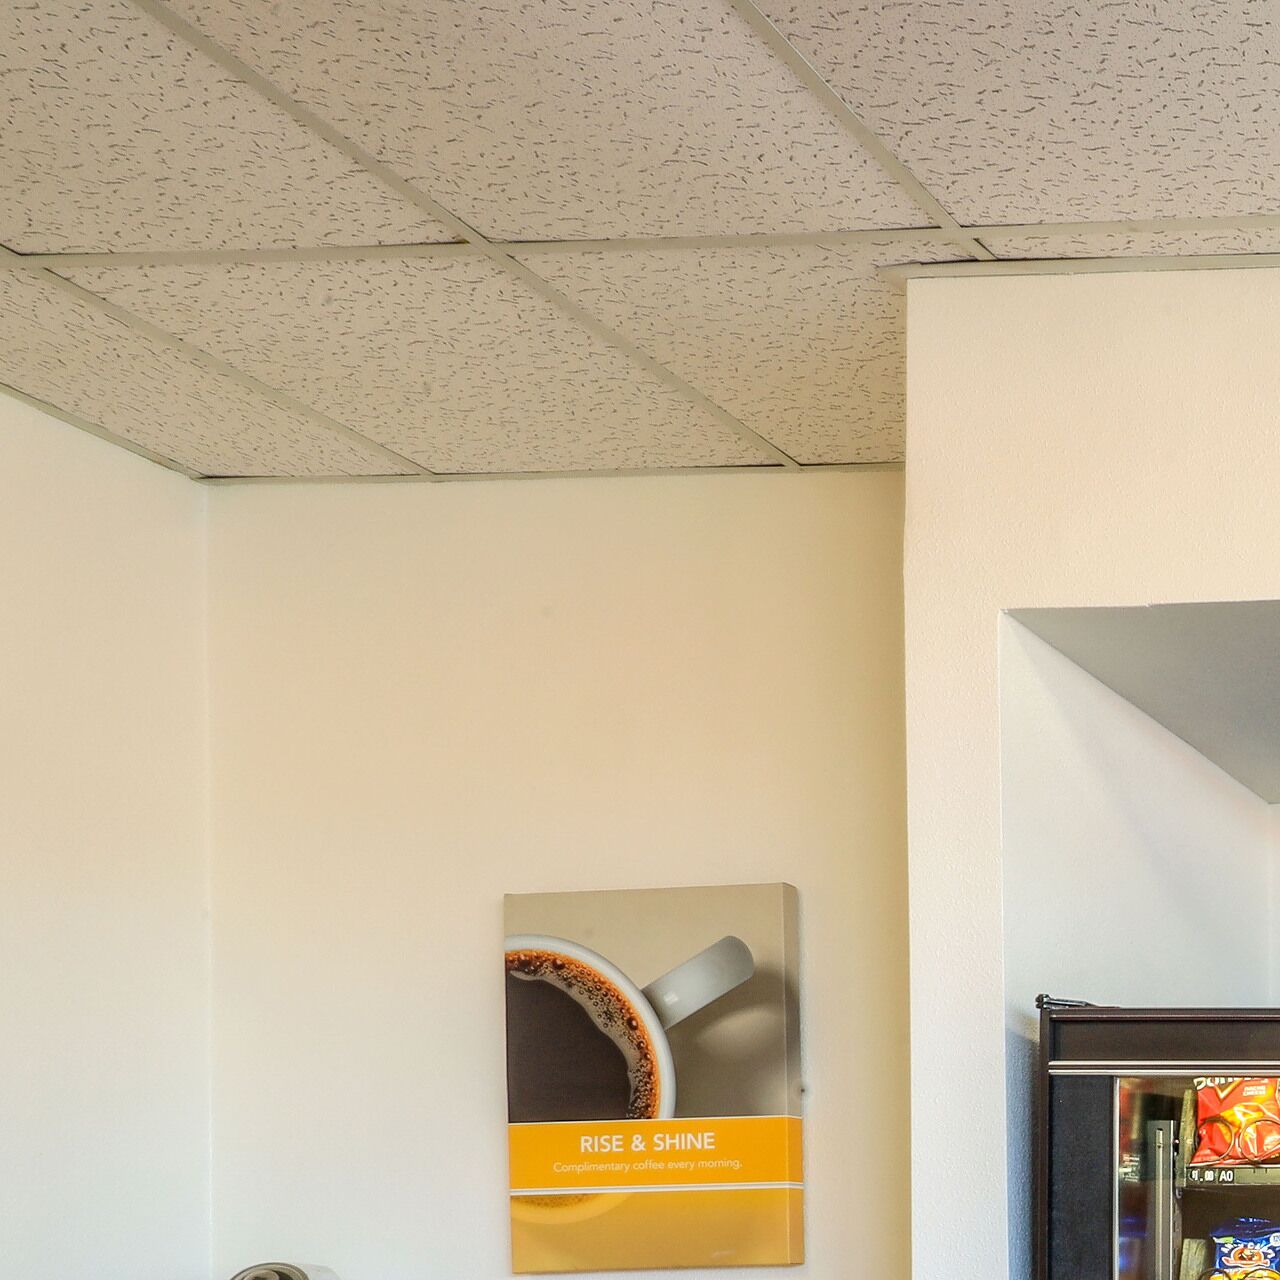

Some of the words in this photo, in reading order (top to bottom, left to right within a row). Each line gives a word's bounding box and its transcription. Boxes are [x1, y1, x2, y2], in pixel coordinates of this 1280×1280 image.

[580, 1134, 623, 1153] RISE
[631, 1134, 646, 1152] &
[653, 1132, 716, 1151] SHINE
[553, 1160, 631, 1174] Complimentary
[633, 1158, 665, 1170] coffee
[667, 1160, 695, 1172] every
[698, 1158, 743, 1170] morning.
[1219, 1170, 1233, 1182] A0
